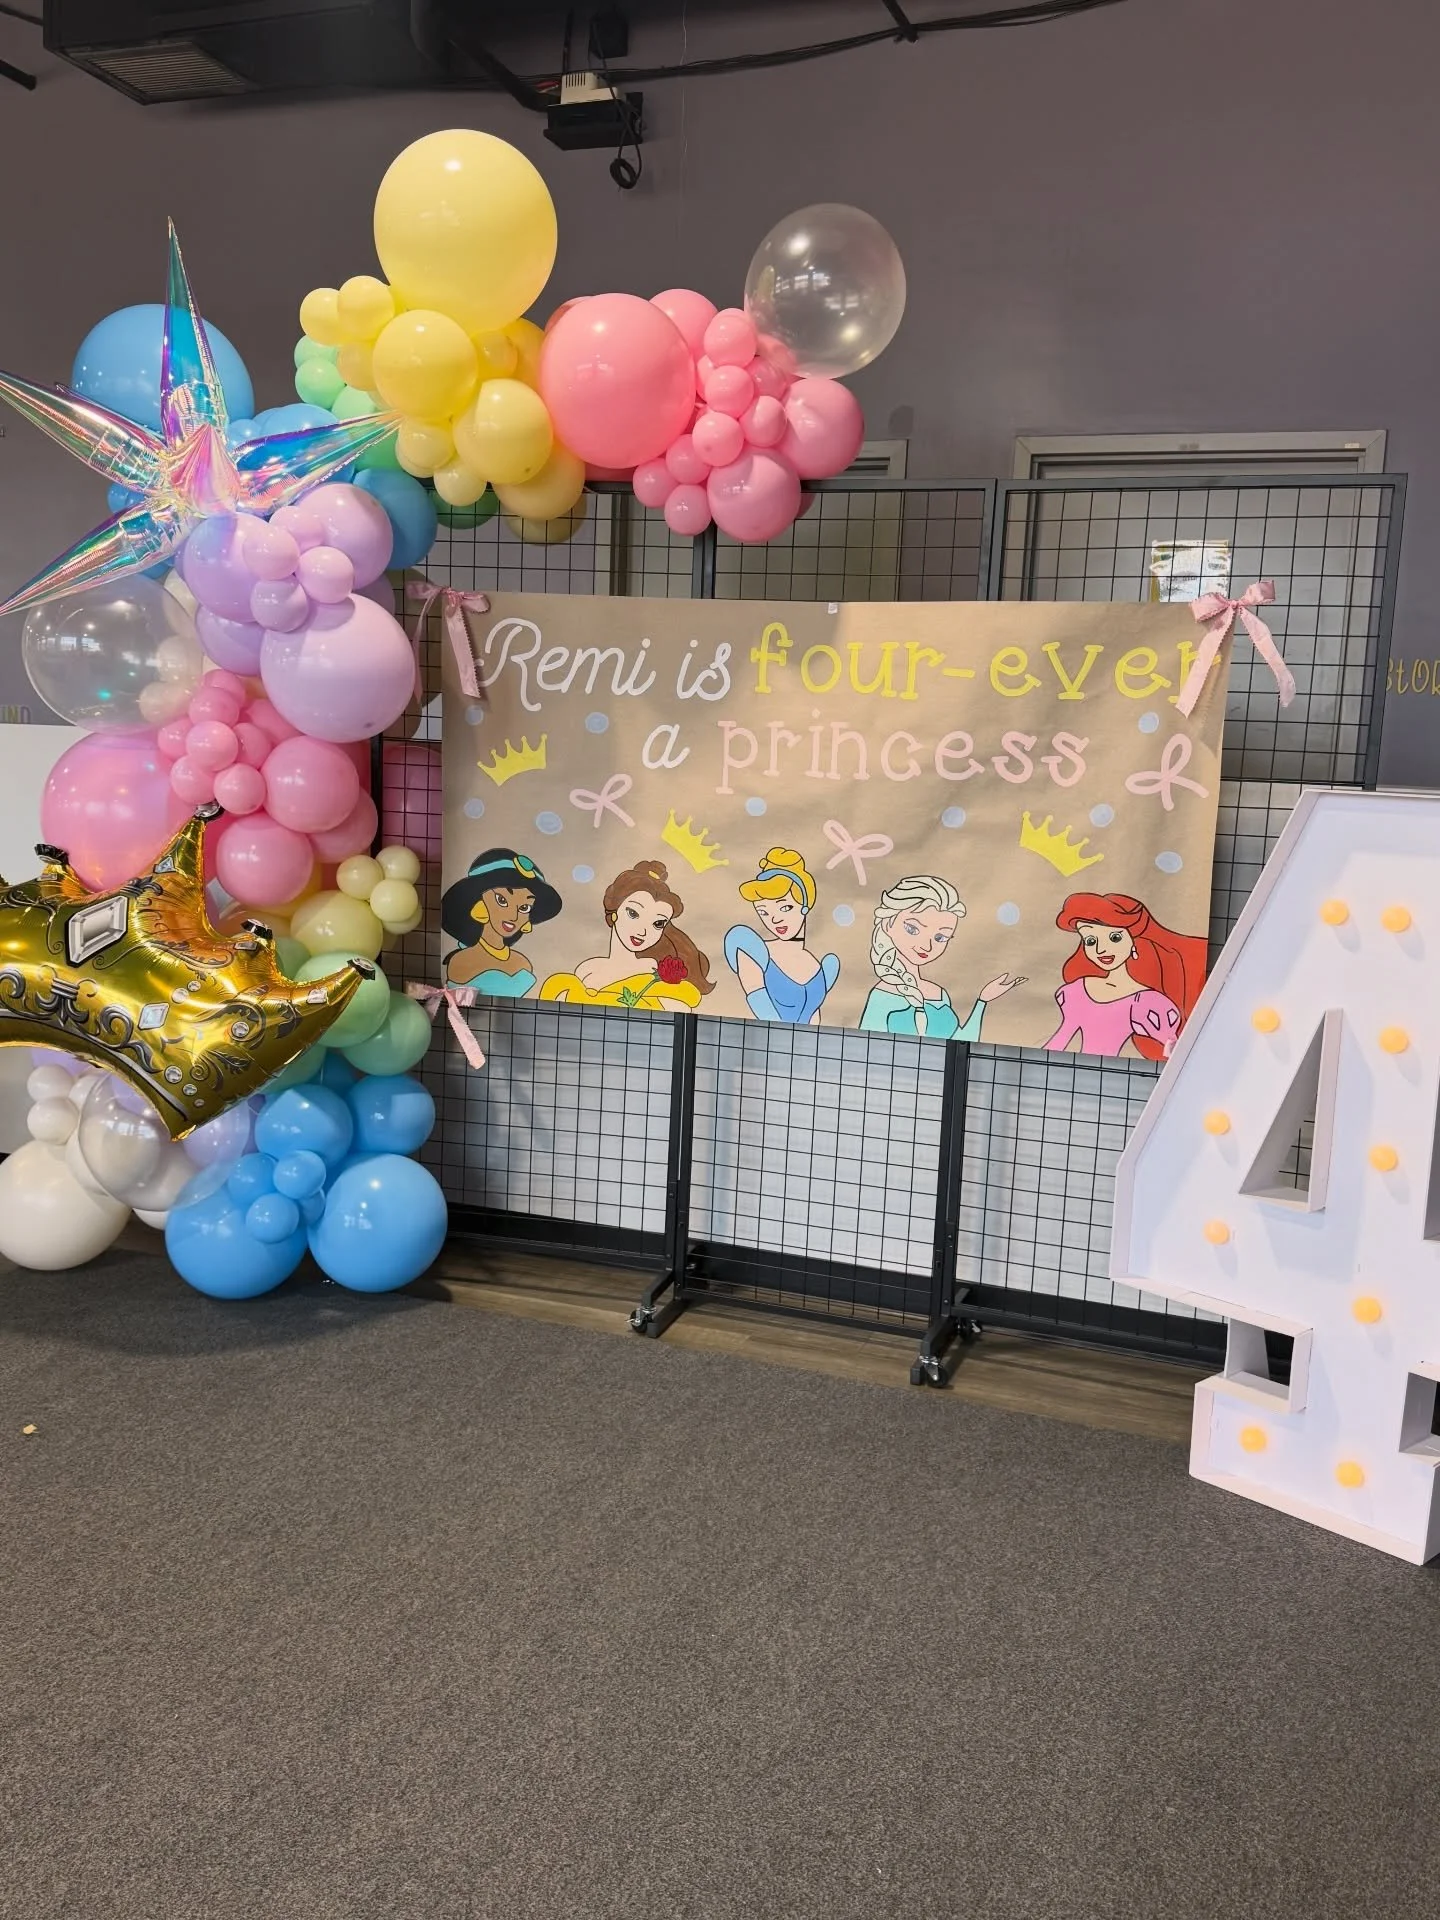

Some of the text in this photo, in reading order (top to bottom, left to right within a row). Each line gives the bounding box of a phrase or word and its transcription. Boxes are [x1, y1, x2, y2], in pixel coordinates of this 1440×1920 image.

[477, 617, 1222, 711] Remi is four-ever
[641, 708, 1091, 795] a princess
[1110, 787, 1440, 1566] 4
